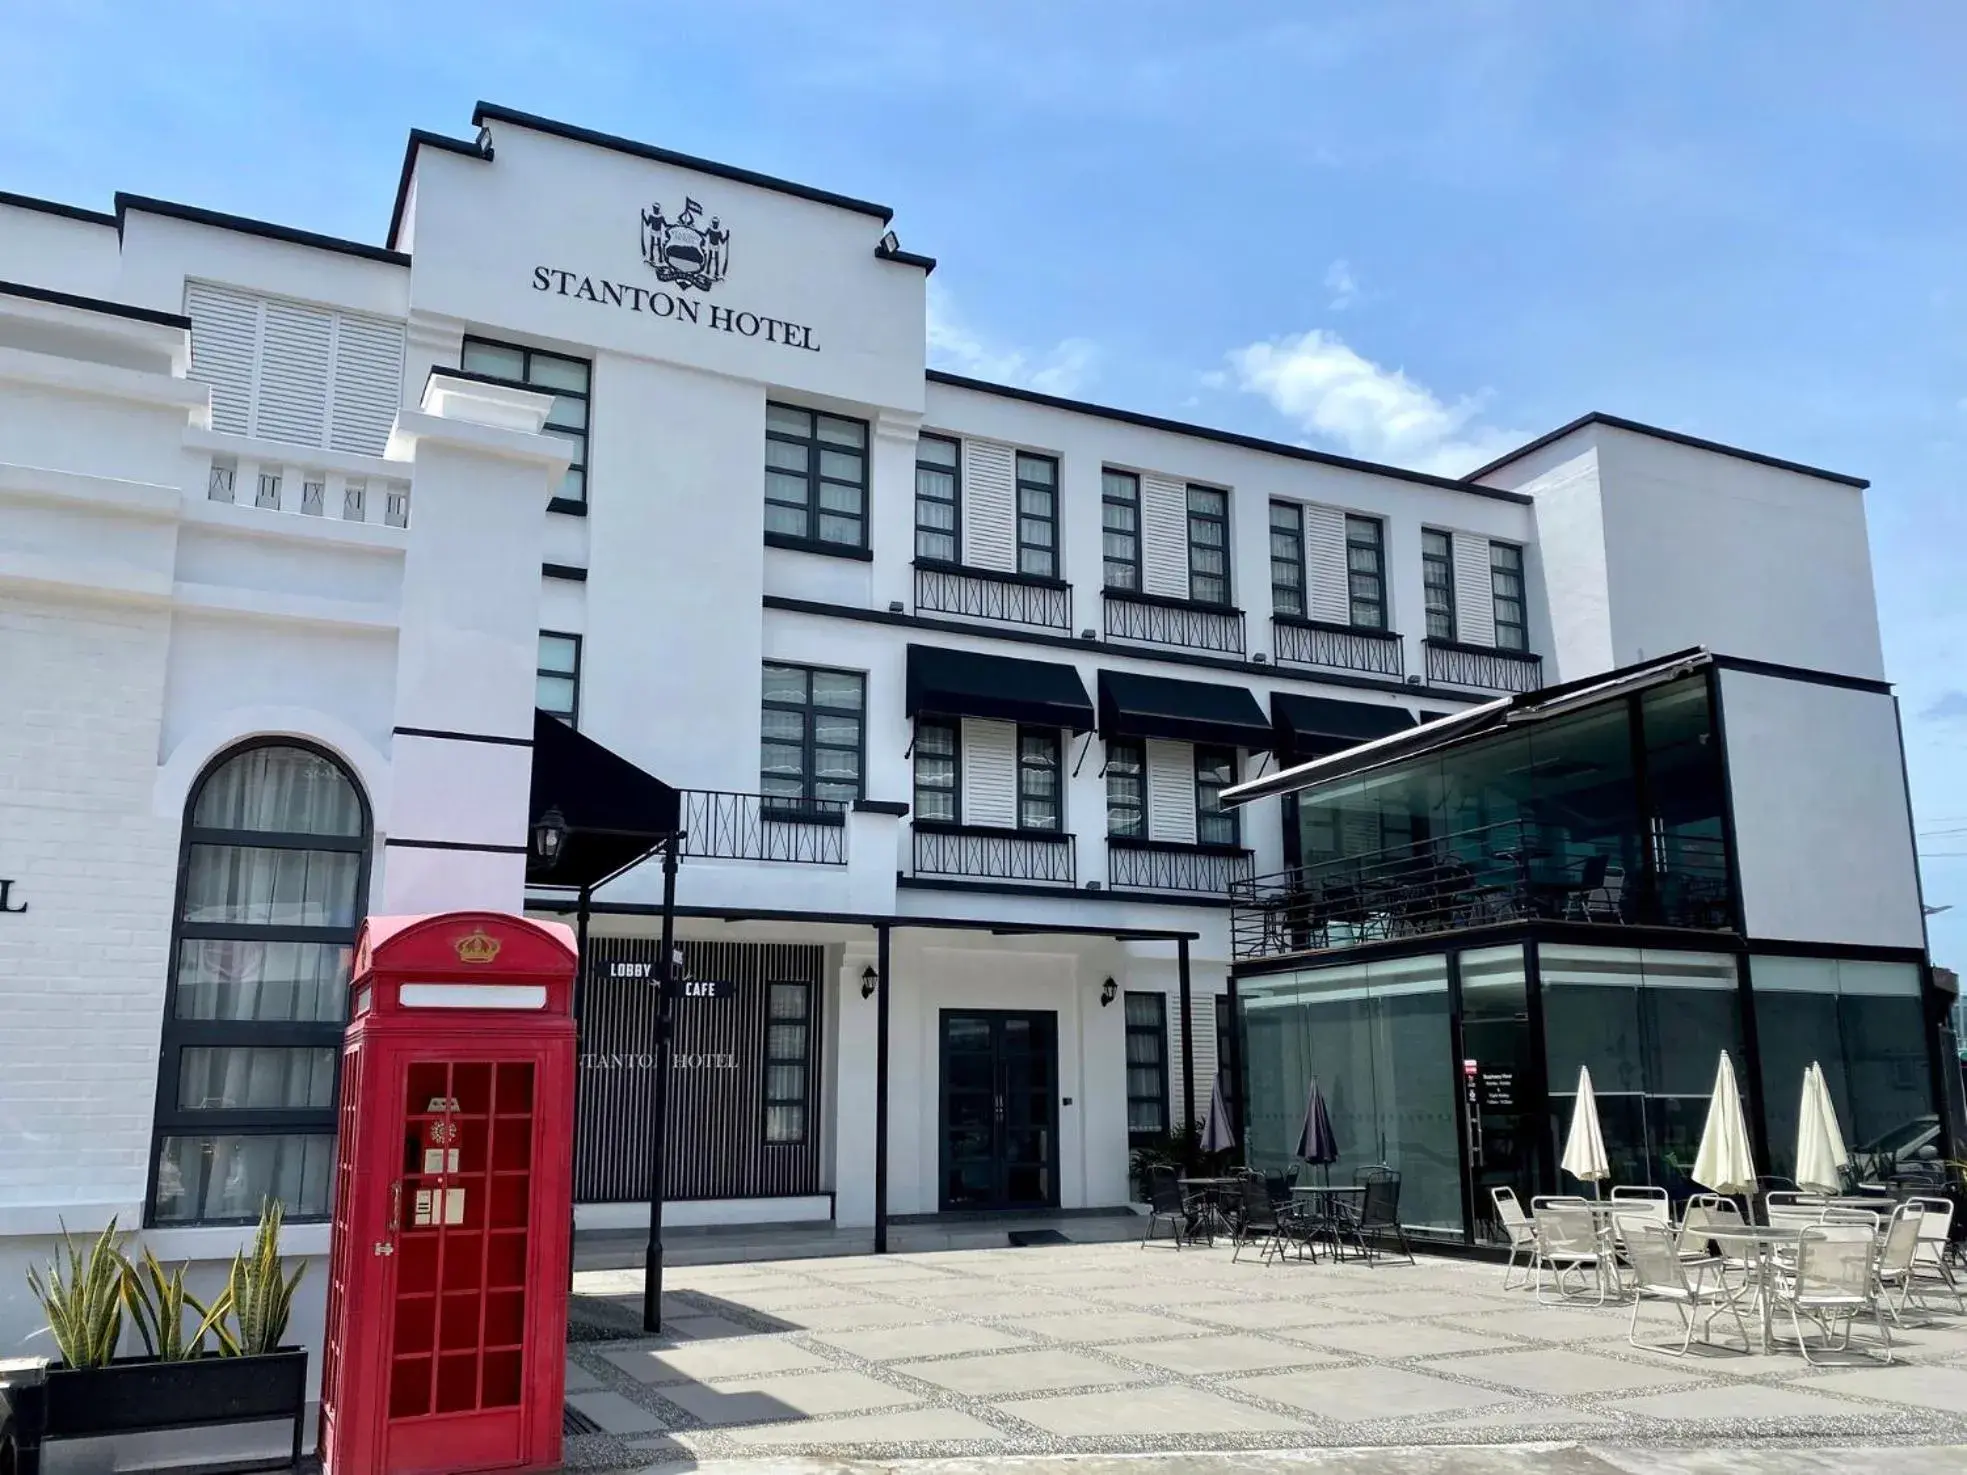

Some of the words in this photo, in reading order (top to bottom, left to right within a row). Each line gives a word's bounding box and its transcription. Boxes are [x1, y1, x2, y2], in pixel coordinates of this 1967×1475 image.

[532, 266, 701, 323] STANTON
[709, 304, 820, 351] HOTEL
[610, 963, 651, 977] LOBBY
[685, 982, 715, 996] CAFE
[579, 1053, 657, 1069] TANTO
[673, 1053, 738, 1069] HOTEL
